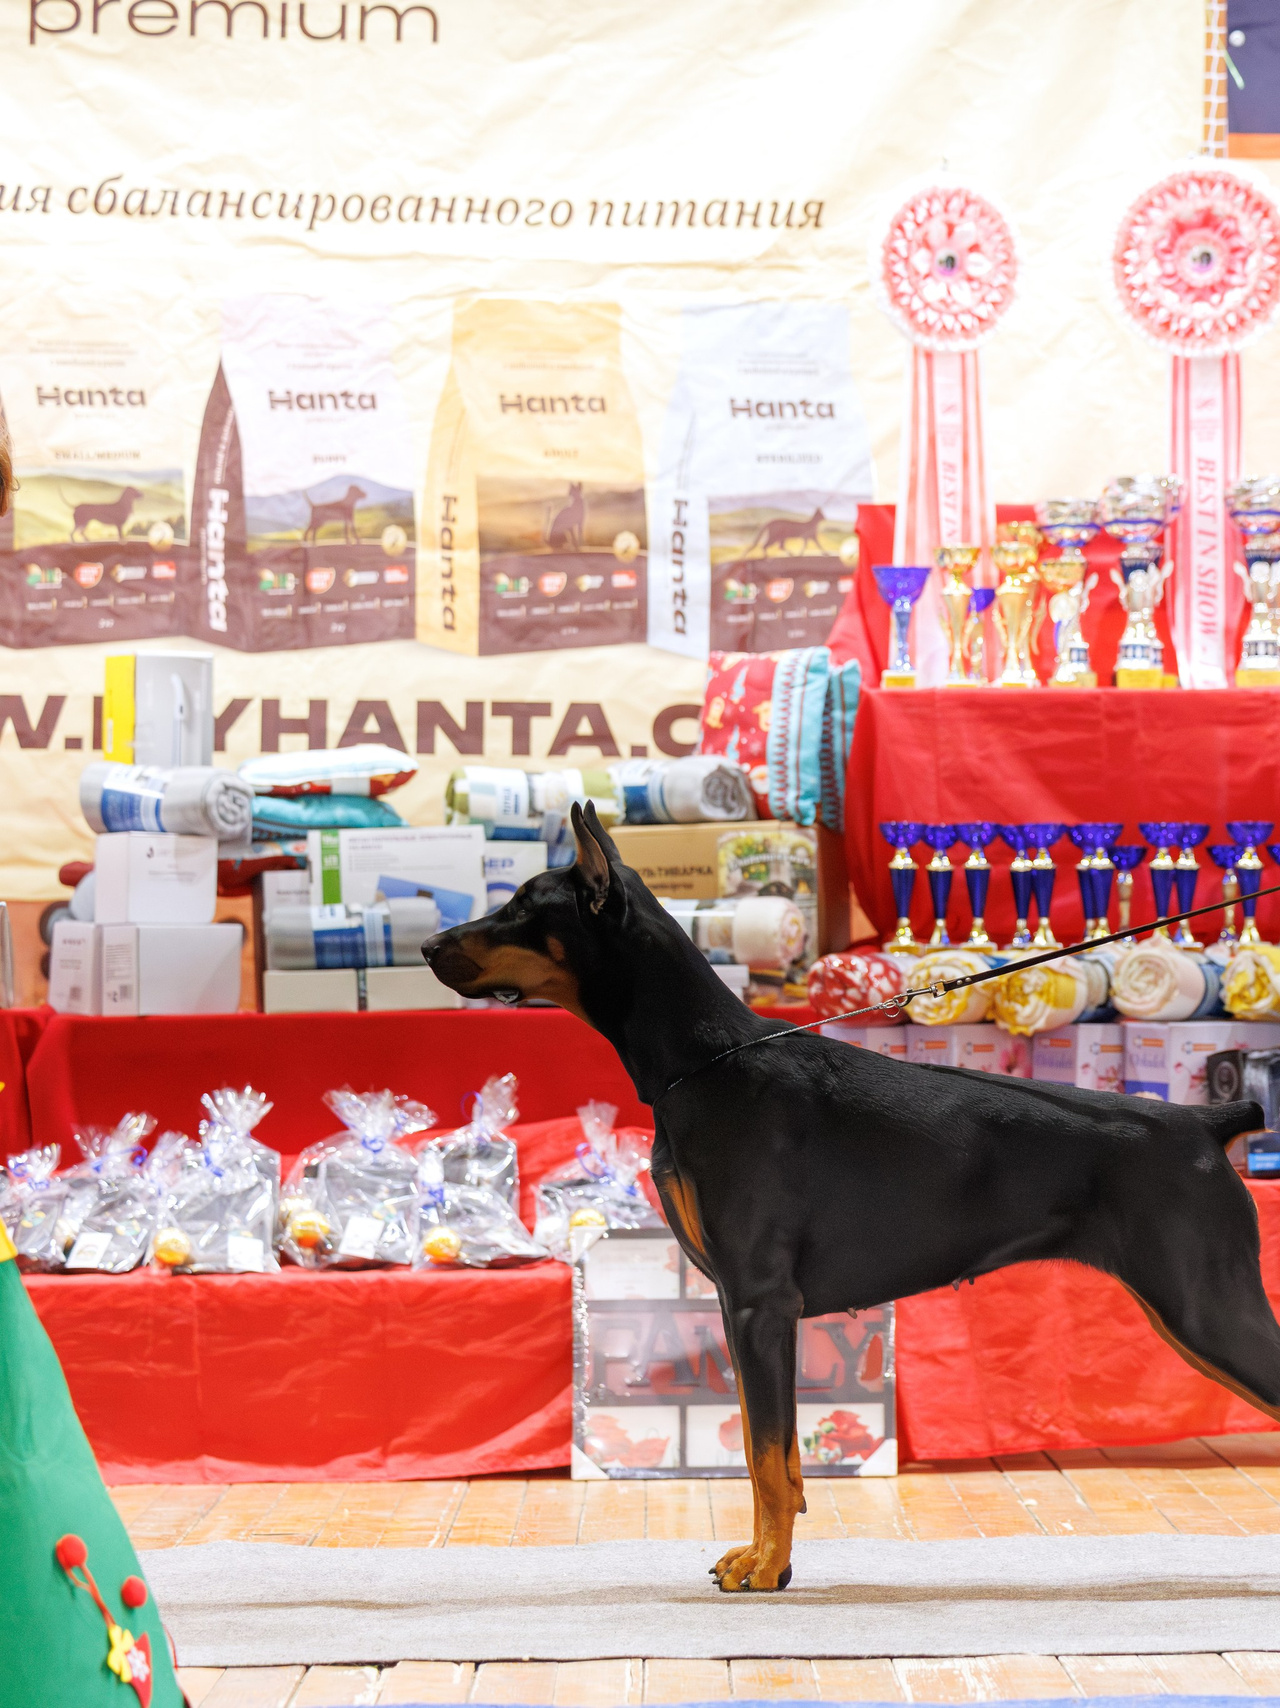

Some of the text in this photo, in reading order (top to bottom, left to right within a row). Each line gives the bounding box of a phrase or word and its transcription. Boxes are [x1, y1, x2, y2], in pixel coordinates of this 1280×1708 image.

[29, 0, 438, 45] premium
[67, 175, 573, 231] сбалансированного
[588, 200, 825, 230] питания
[36, 386, 147, 406] Hanta
[268, 389, 378, 410] Hanta
[499, 394, 607, 413] Hanta
[730, 398, 836, 419] Hanta
[205, 488, 230, 632] Hanta
[439, 495, 458, 633] Hanta
[671, 499, 688, 635] Hanta
[1196, 456, 1218, 635] BEST IN SHOW
[0, 693, 704, 759] W.YHANTA.C
[590, 1308, 890, 1397] FAMLY
